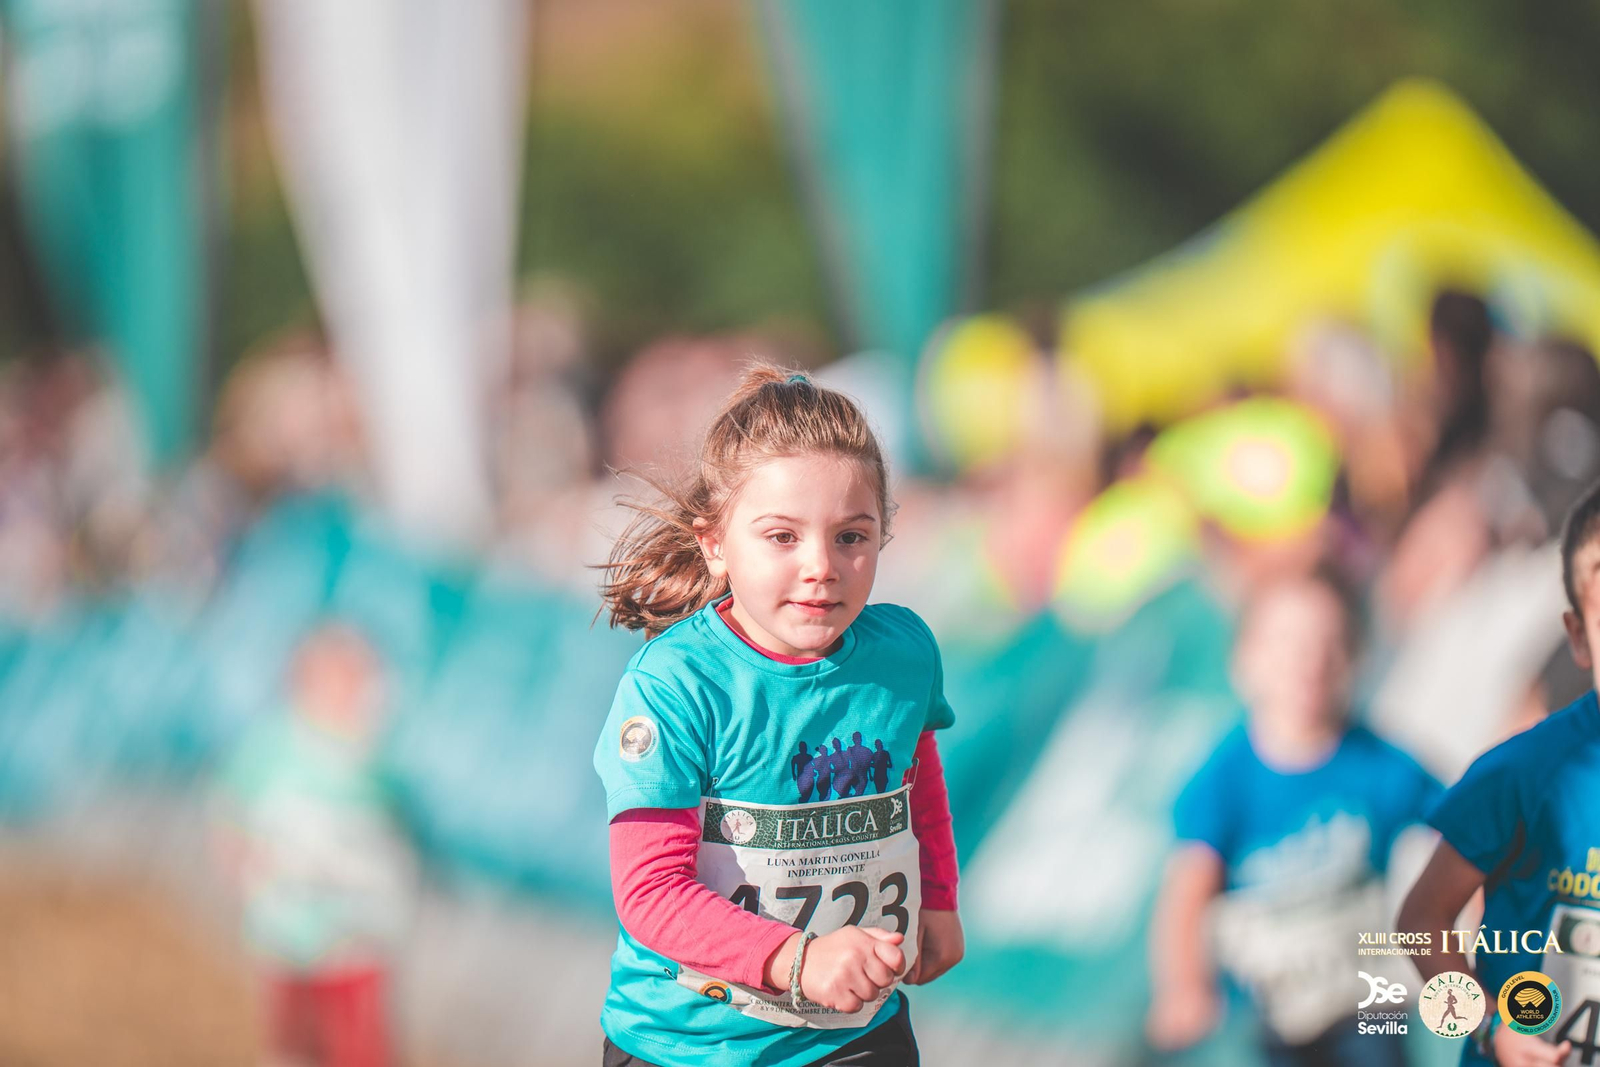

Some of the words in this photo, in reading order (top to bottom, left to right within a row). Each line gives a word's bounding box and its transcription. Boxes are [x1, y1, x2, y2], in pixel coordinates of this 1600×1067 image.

[774, 809, 878, 841] ITÁLICA
[774, 840, 829, 849] INTERNATIONAL
[831, 837, 850, 845] CROSS
[767, 857, 796, 867] LUNA
[798, 854, 838, 866] MARTIN
[787, 863, 866, 878] INDEPENDIENTE
